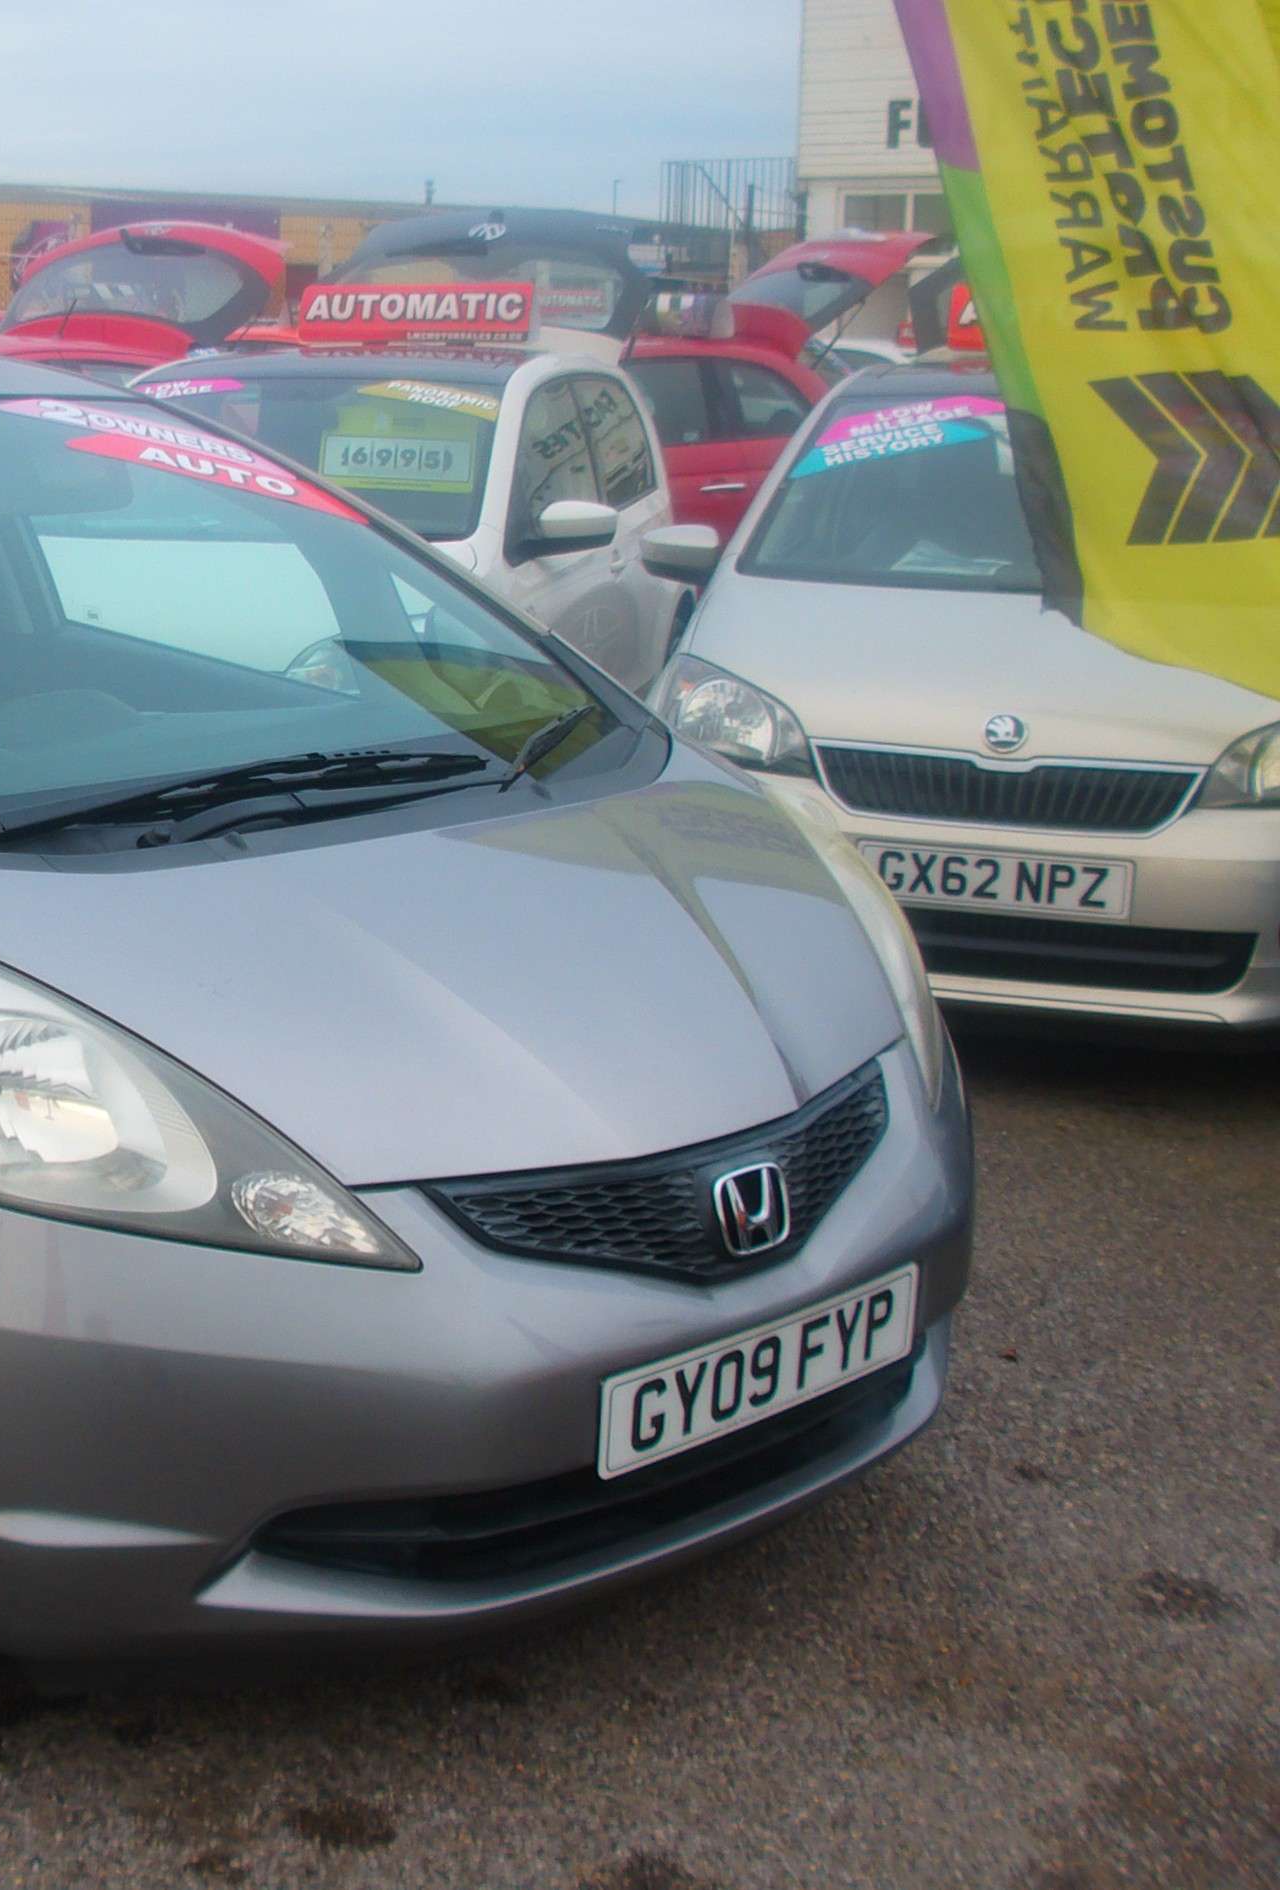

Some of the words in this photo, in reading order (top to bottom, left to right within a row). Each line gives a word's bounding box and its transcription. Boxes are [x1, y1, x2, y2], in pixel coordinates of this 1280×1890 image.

[305, 293, 523, 320] AUTOMATIC
[387, 380, 497, 410] PANORAMIC
[875, 402, 933, 422] LOW
[38, 400, 87, 426] 2
[87, 411, 254, 464] OWNERS
[848, 406, 971, 437] MILEAGE
[822, 422, 939, 456] SERVICE
[824, 432, 944, 467] HISTORY
[138, 446, 297, 496] AUTO
[878, 850, 1001, 900] GX62
[1015, 861, 1110, 909] NPZ
[631, 1335, 781, 1452] GY09
[796, 1288, 894, 1390] FYP
